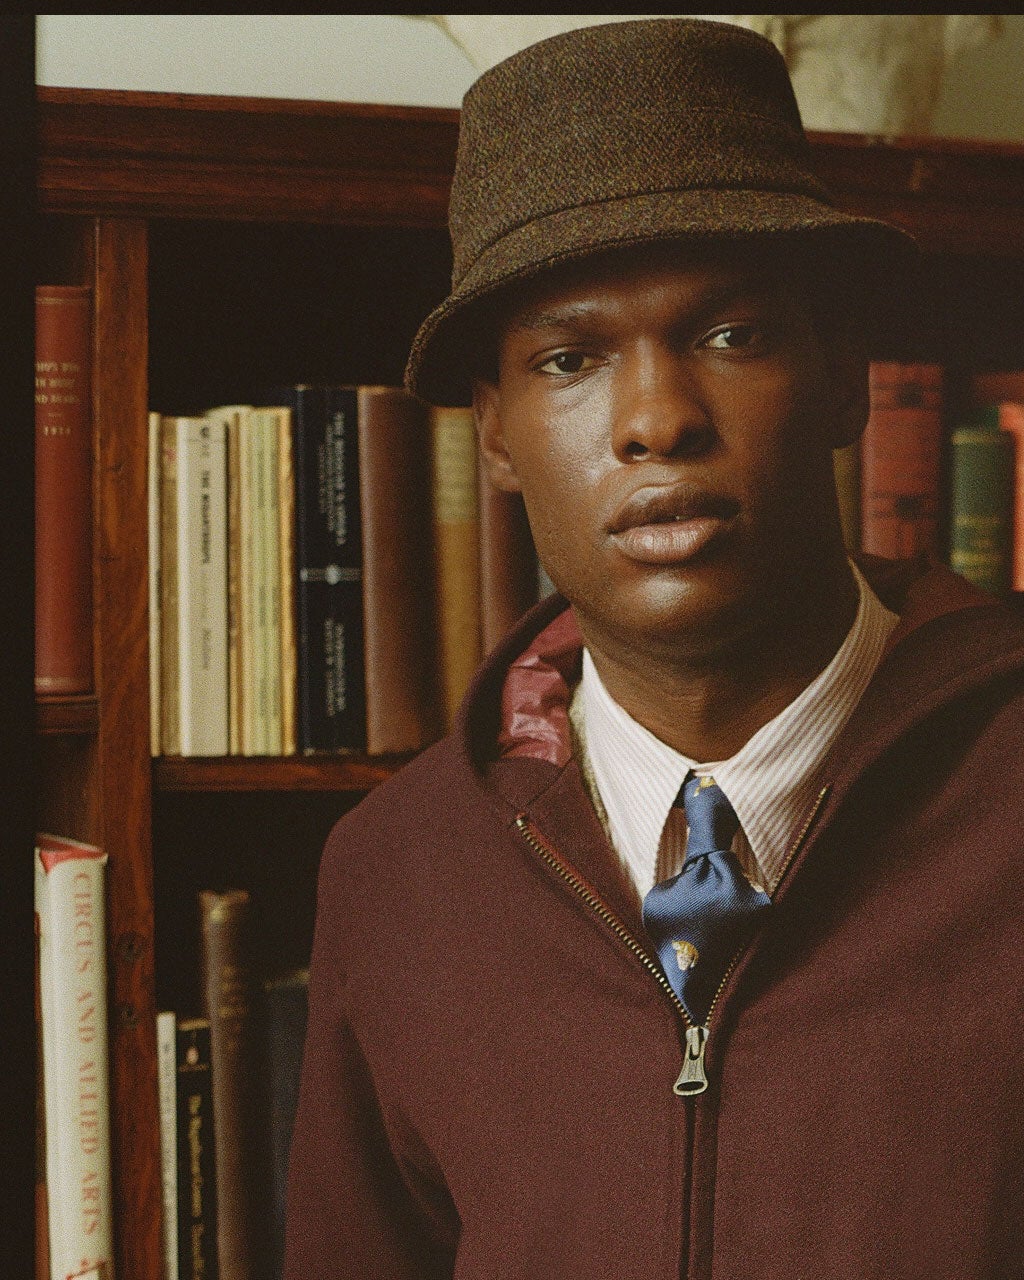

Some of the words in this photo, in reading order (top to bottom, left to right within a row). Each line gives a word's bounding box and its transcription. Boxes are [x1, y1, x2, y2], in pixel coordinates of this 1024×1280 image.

[73, 872, 94, 974] CIRCUS
[76, 990, 97, 1044] AND
[79, 1059, 100, 1156] ALLIED
[80, 1170, 101, 1237] ARTS
